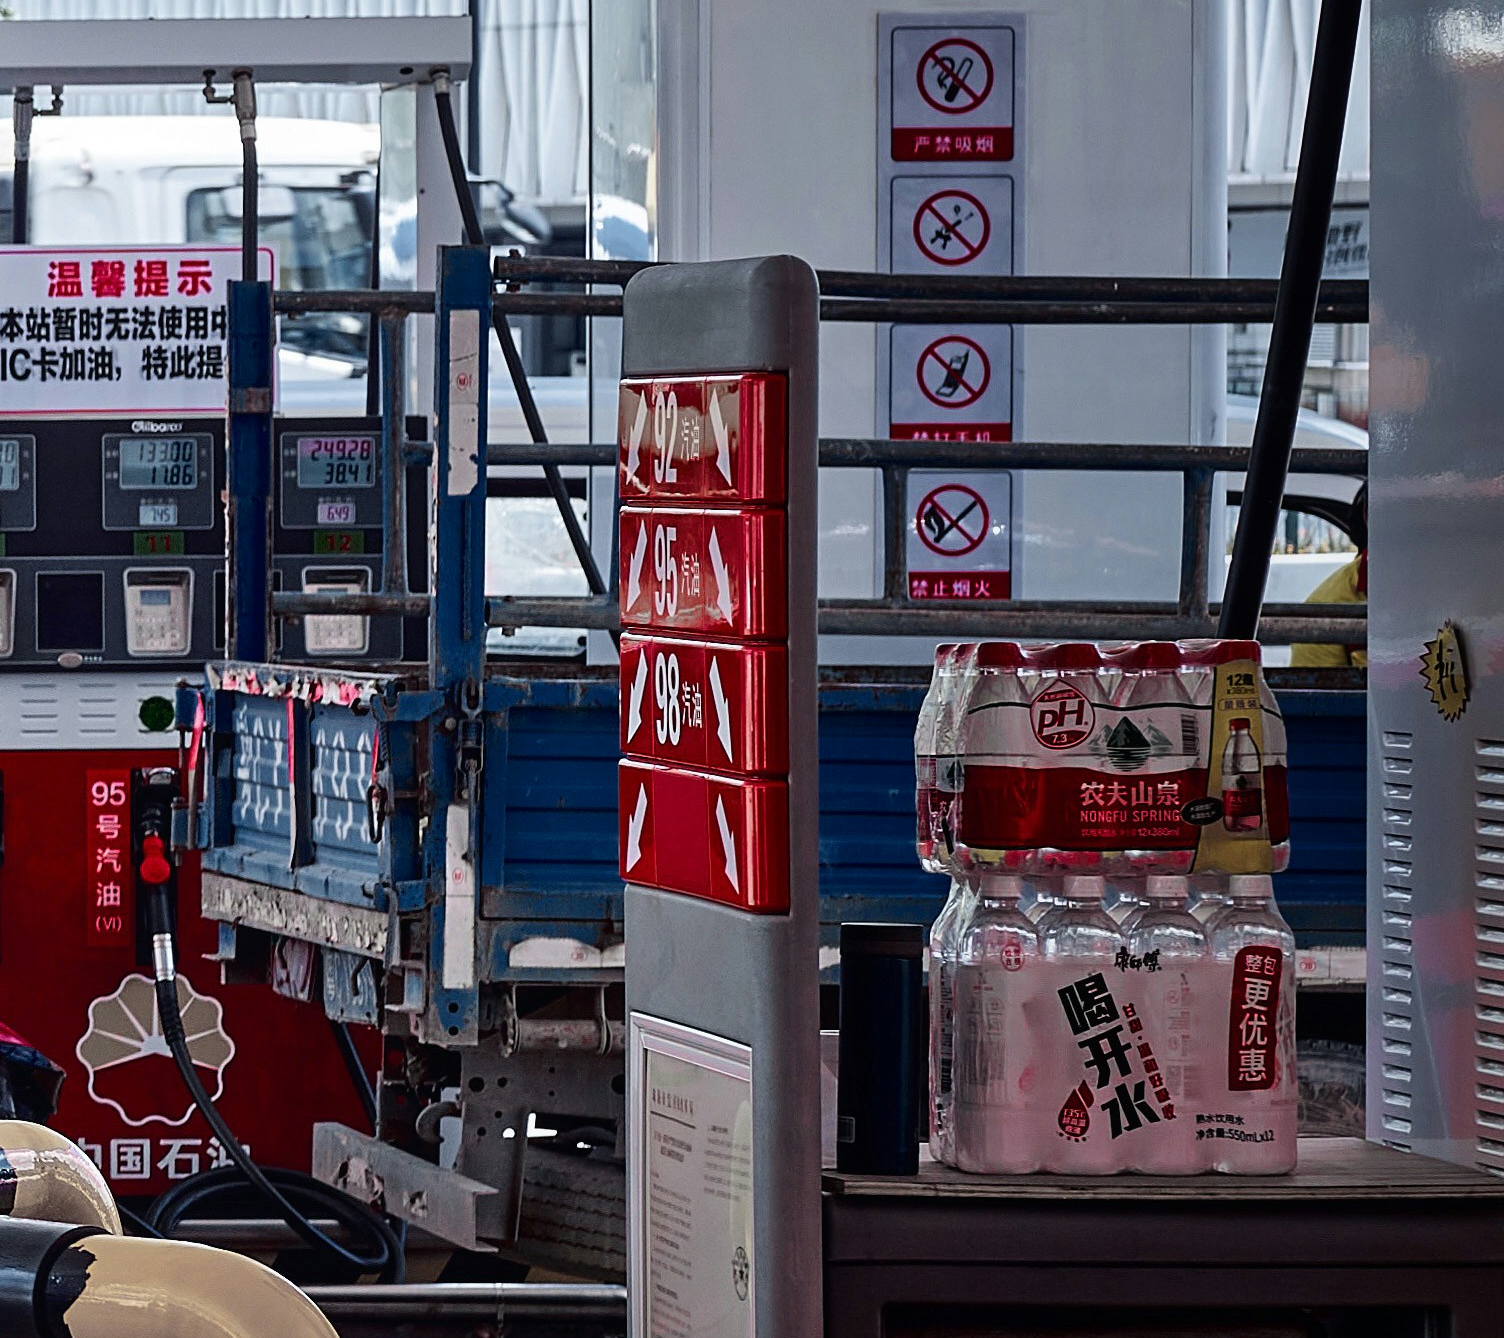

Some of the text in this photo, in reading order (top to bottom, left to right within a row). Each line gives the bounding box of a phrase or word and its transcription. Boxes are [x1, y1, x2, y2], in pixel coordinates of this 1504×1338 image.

[914, 136, 994, 154] 严禁吸烟
[47, 260, 212, 298] 温馨提示
[654, 391, 678, 484] 92
[326, 534, 351, 553] 12
[654, 524, 678, 618] 95
[912, 579, 991, 599] 禁止烟火
[654, 652, 680, 745] 98
[1080, 781, 1180, 807] 农夫山泉
[1080, 811, 1127, 822] NONGFU
[1133, 810, 1181, 822] SPRING
[1245, 954, 1276, 976] 整包
[1239, 976, 1273, 1083] 更优惠
[1057, 972, 1161, 1139] 喝开水
